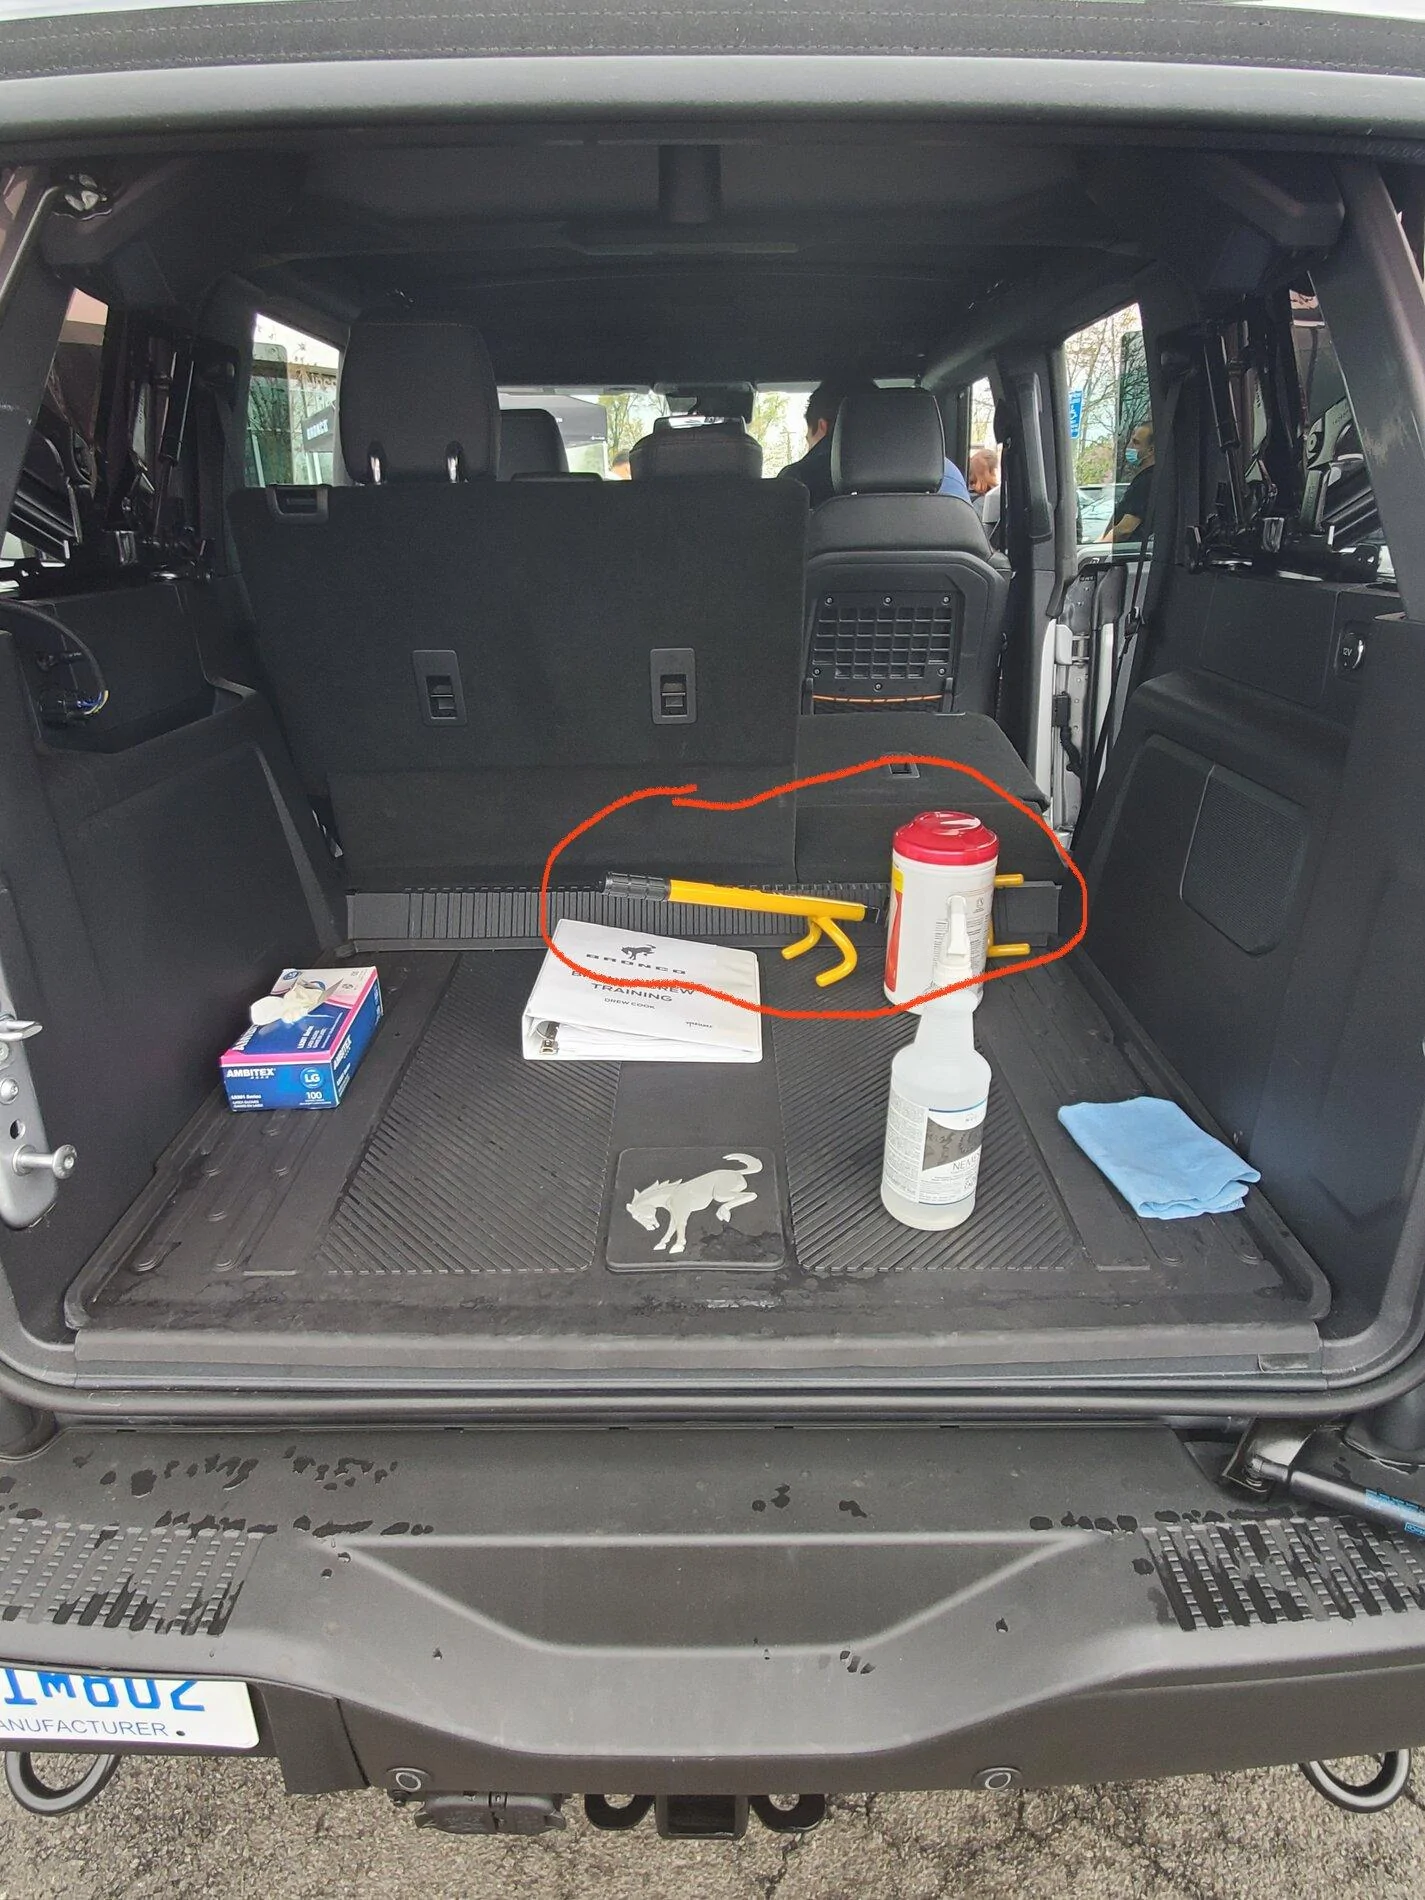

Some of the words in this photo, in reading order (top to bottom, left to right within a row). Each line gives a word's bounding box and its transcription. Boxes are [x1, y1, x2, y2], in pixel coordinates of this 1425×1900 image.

[586, 953, 686, 975] BRONCO
[591, 982, 674, 1002] TRAINING
[604, 997, 630, 1005] DREW
[630, 1001, 656, 1010] COOK
[226, 1068, 275, 1078] AMBITEX
[304, 1073, 321, 1083] LG
[305, 1091, 323, 1100] 100
